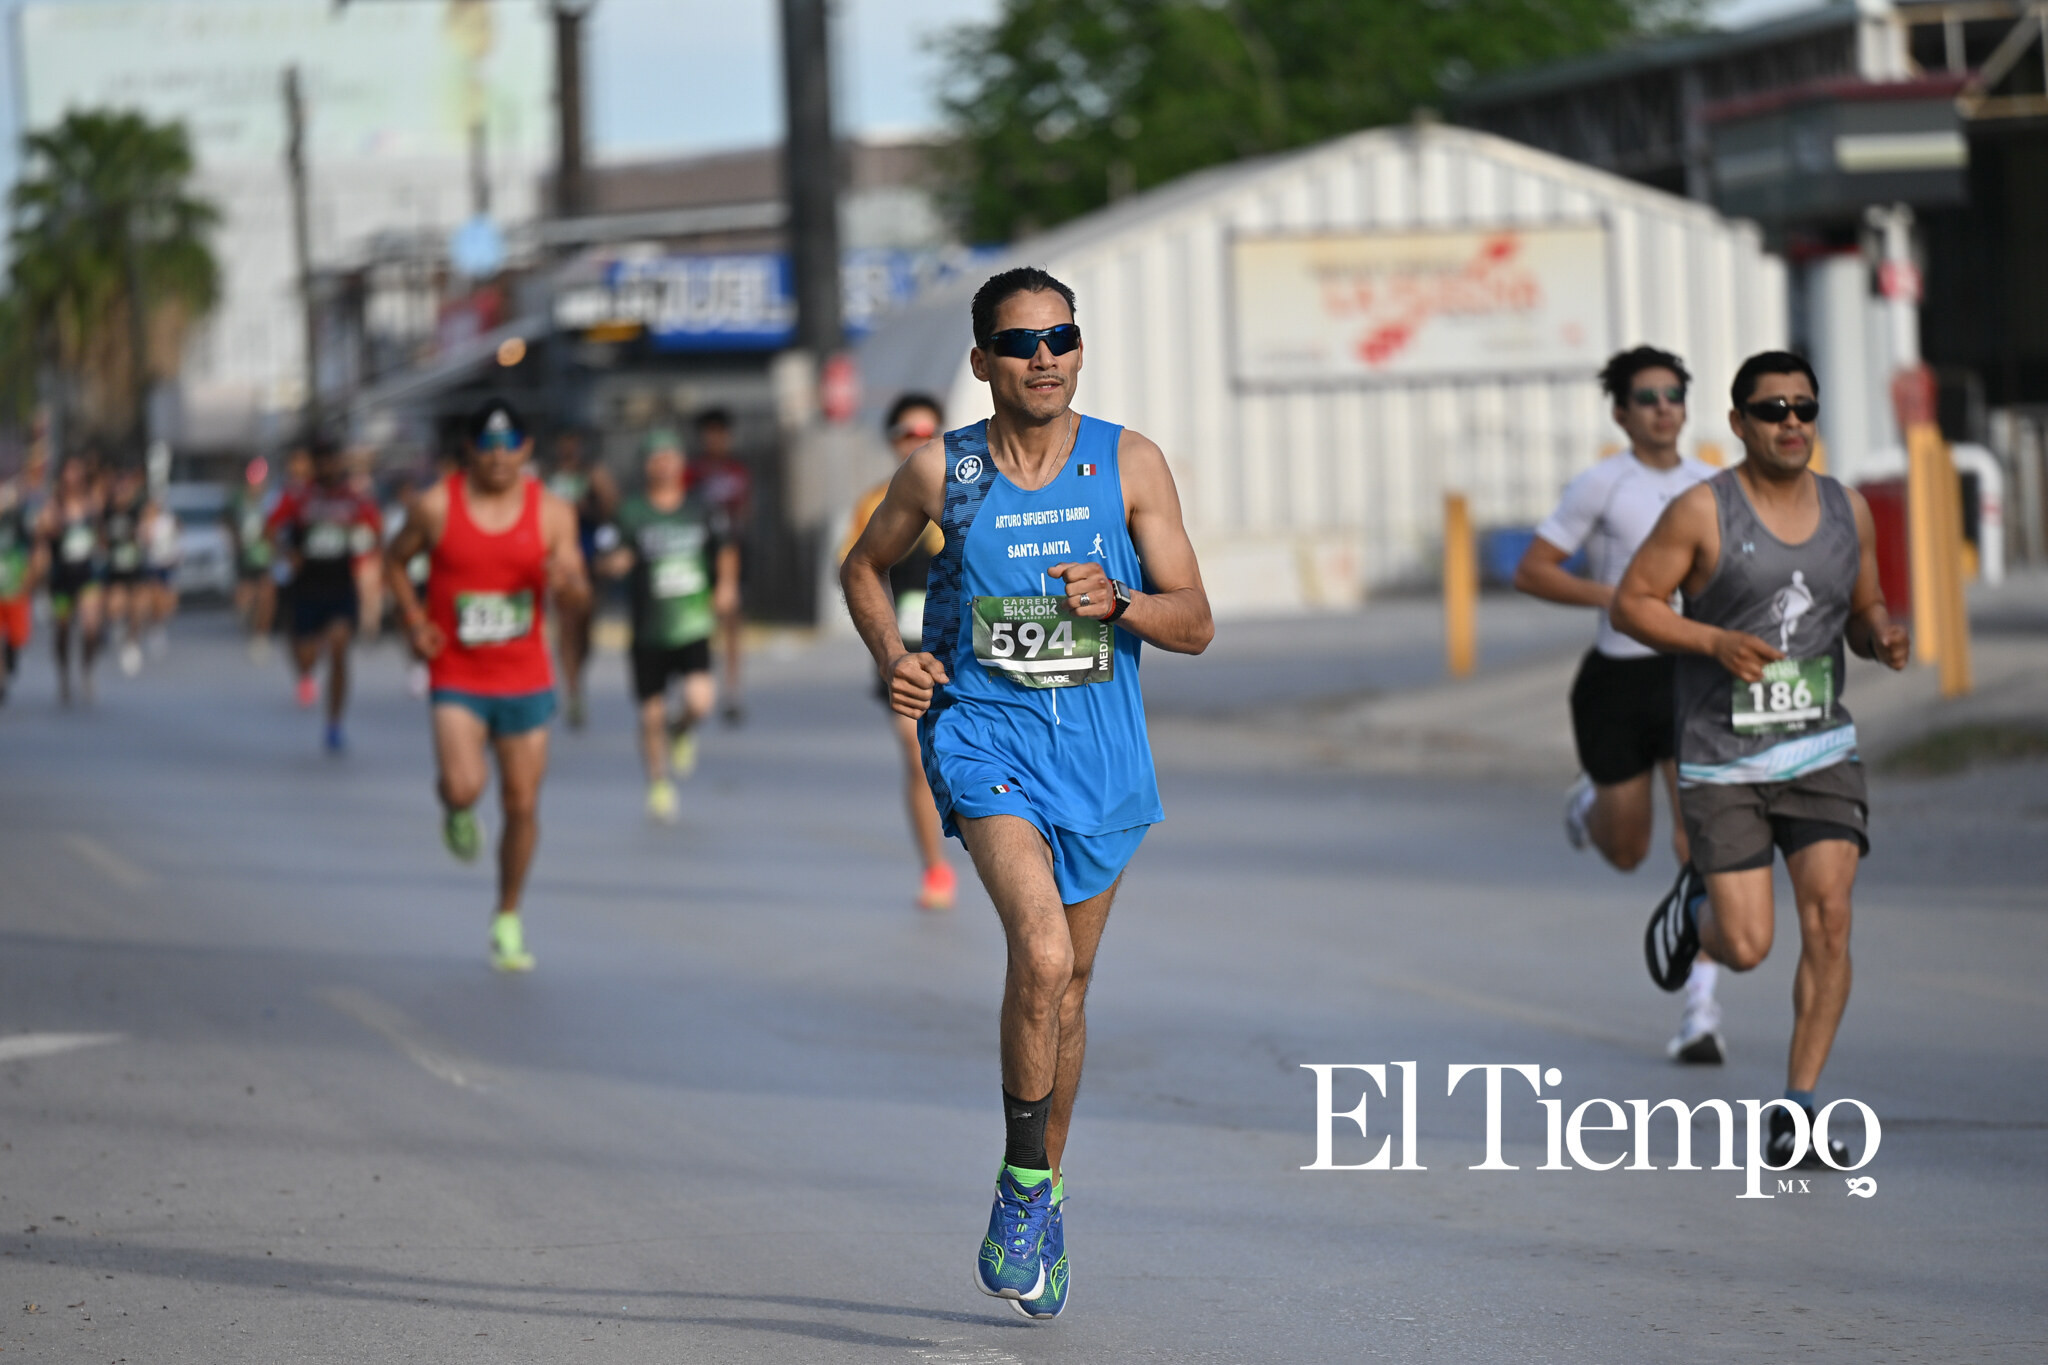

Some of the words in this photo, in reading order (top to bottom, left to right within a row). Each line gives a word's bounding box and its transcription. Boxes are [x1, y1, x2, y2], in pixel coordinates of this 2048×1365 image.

[995, 513, 1021, 529] ARTURO
[1023, 510, 1058, 526] SIFUENTES
[1059, 509, 1064, 522] Y
[1066, 506, 1090, 522] BARRIO
[1007, 543, 1040, 559] SANTA
[1042, 540, 1071, 556] ANITA
[1003, 598, 1057, 606] CARRERA
[992, 621, 1076, 658] 594
[1748, 678, 1813, 713] 186
